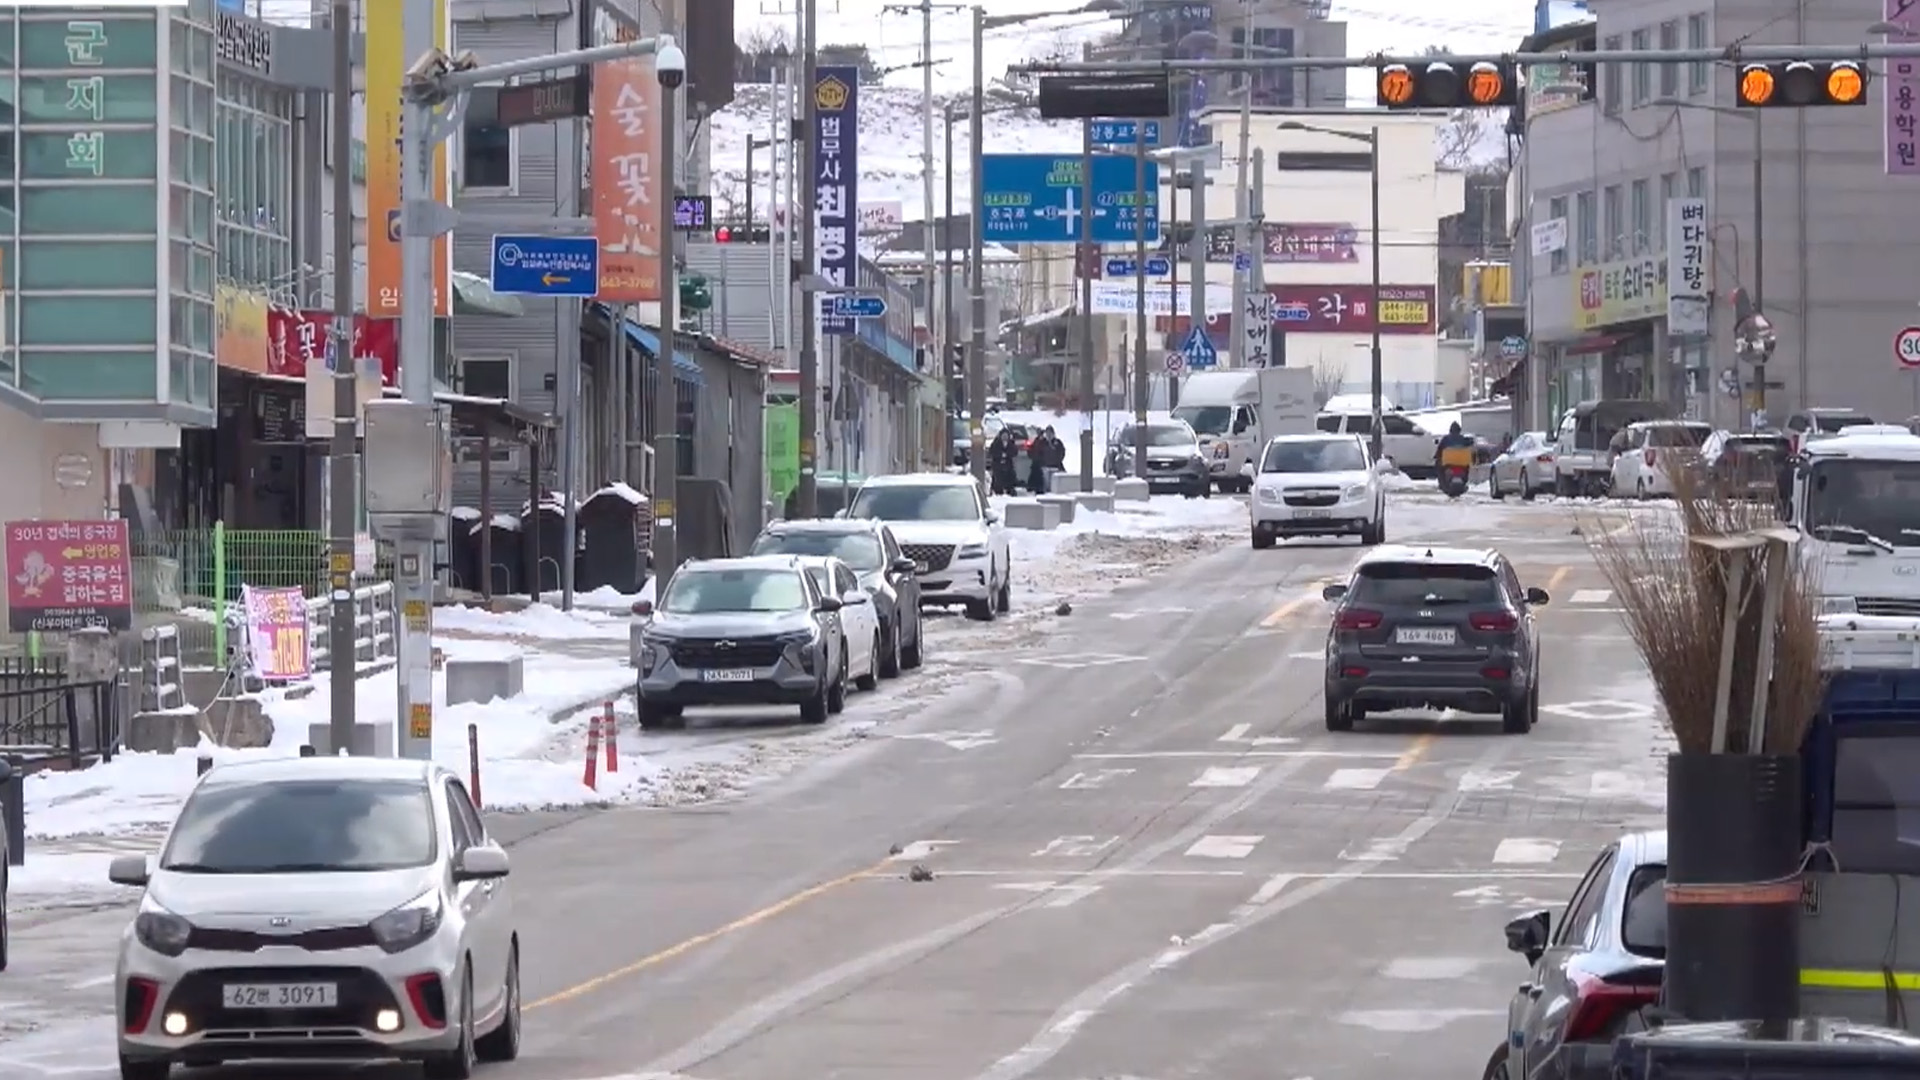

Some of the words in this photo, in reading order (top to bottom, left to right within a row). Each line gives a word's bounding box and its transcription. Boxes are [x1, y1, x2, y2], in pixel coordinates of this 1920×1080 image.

[66, 6, 105, 175] 군지회
[821, 117, 841, 180] 법무사
[990, 208, 1025, 222] 호국로
[1116, 222, 1157, 231] Hogu-ro
[1682, 204, 1705, 290] 뼈다귀탕
[14, 527, 43, 541] 30년
[84, 544, 121, 559] 영업중
[62, 564, 123, 583] 중국음식
[63, 584, 106, 602] 잘하는
[109, 584, 124, 602] 집
[279, 986, 326, 1004] 3091
